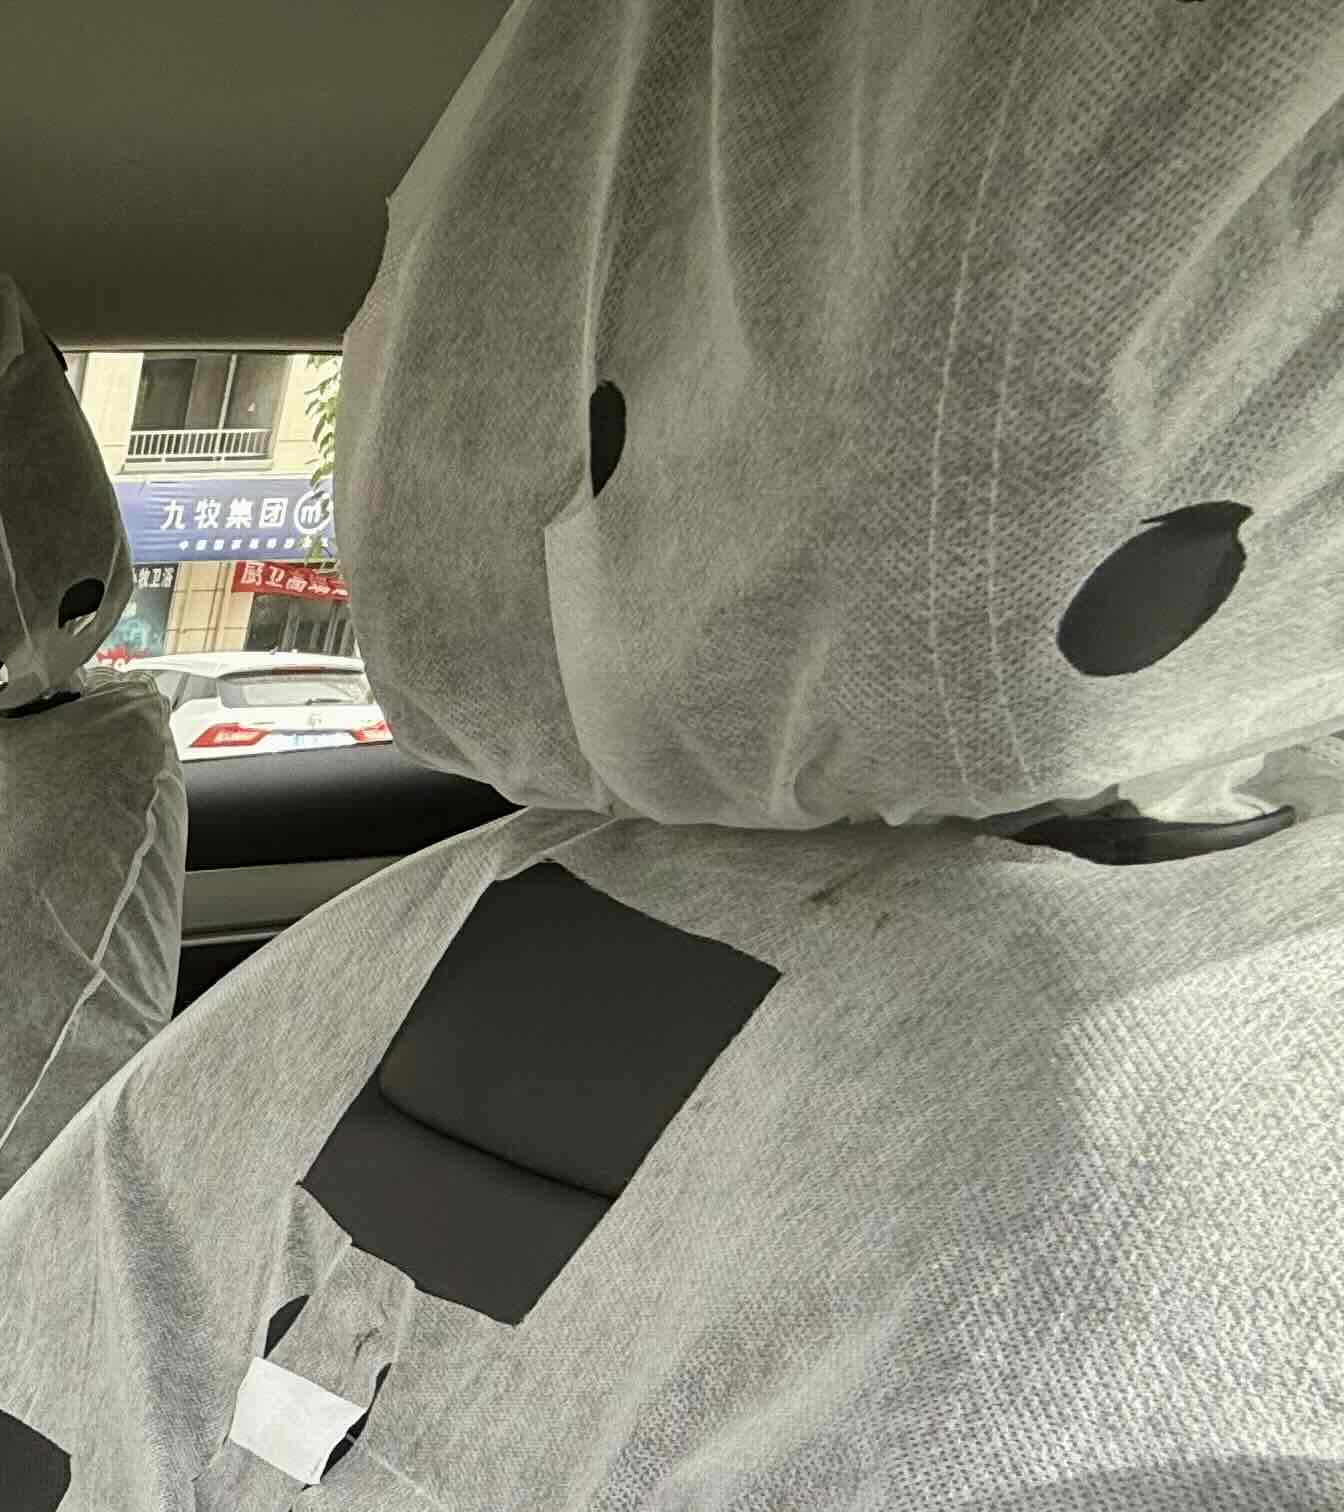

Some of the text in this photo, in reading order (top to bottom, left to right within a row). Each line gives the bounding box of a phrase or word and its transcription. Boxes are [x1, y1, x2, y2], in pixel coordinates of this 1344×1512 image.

[160, 497, 289, 530] 九牧集团
[132, 566, 175, 589] 牧卫浴
